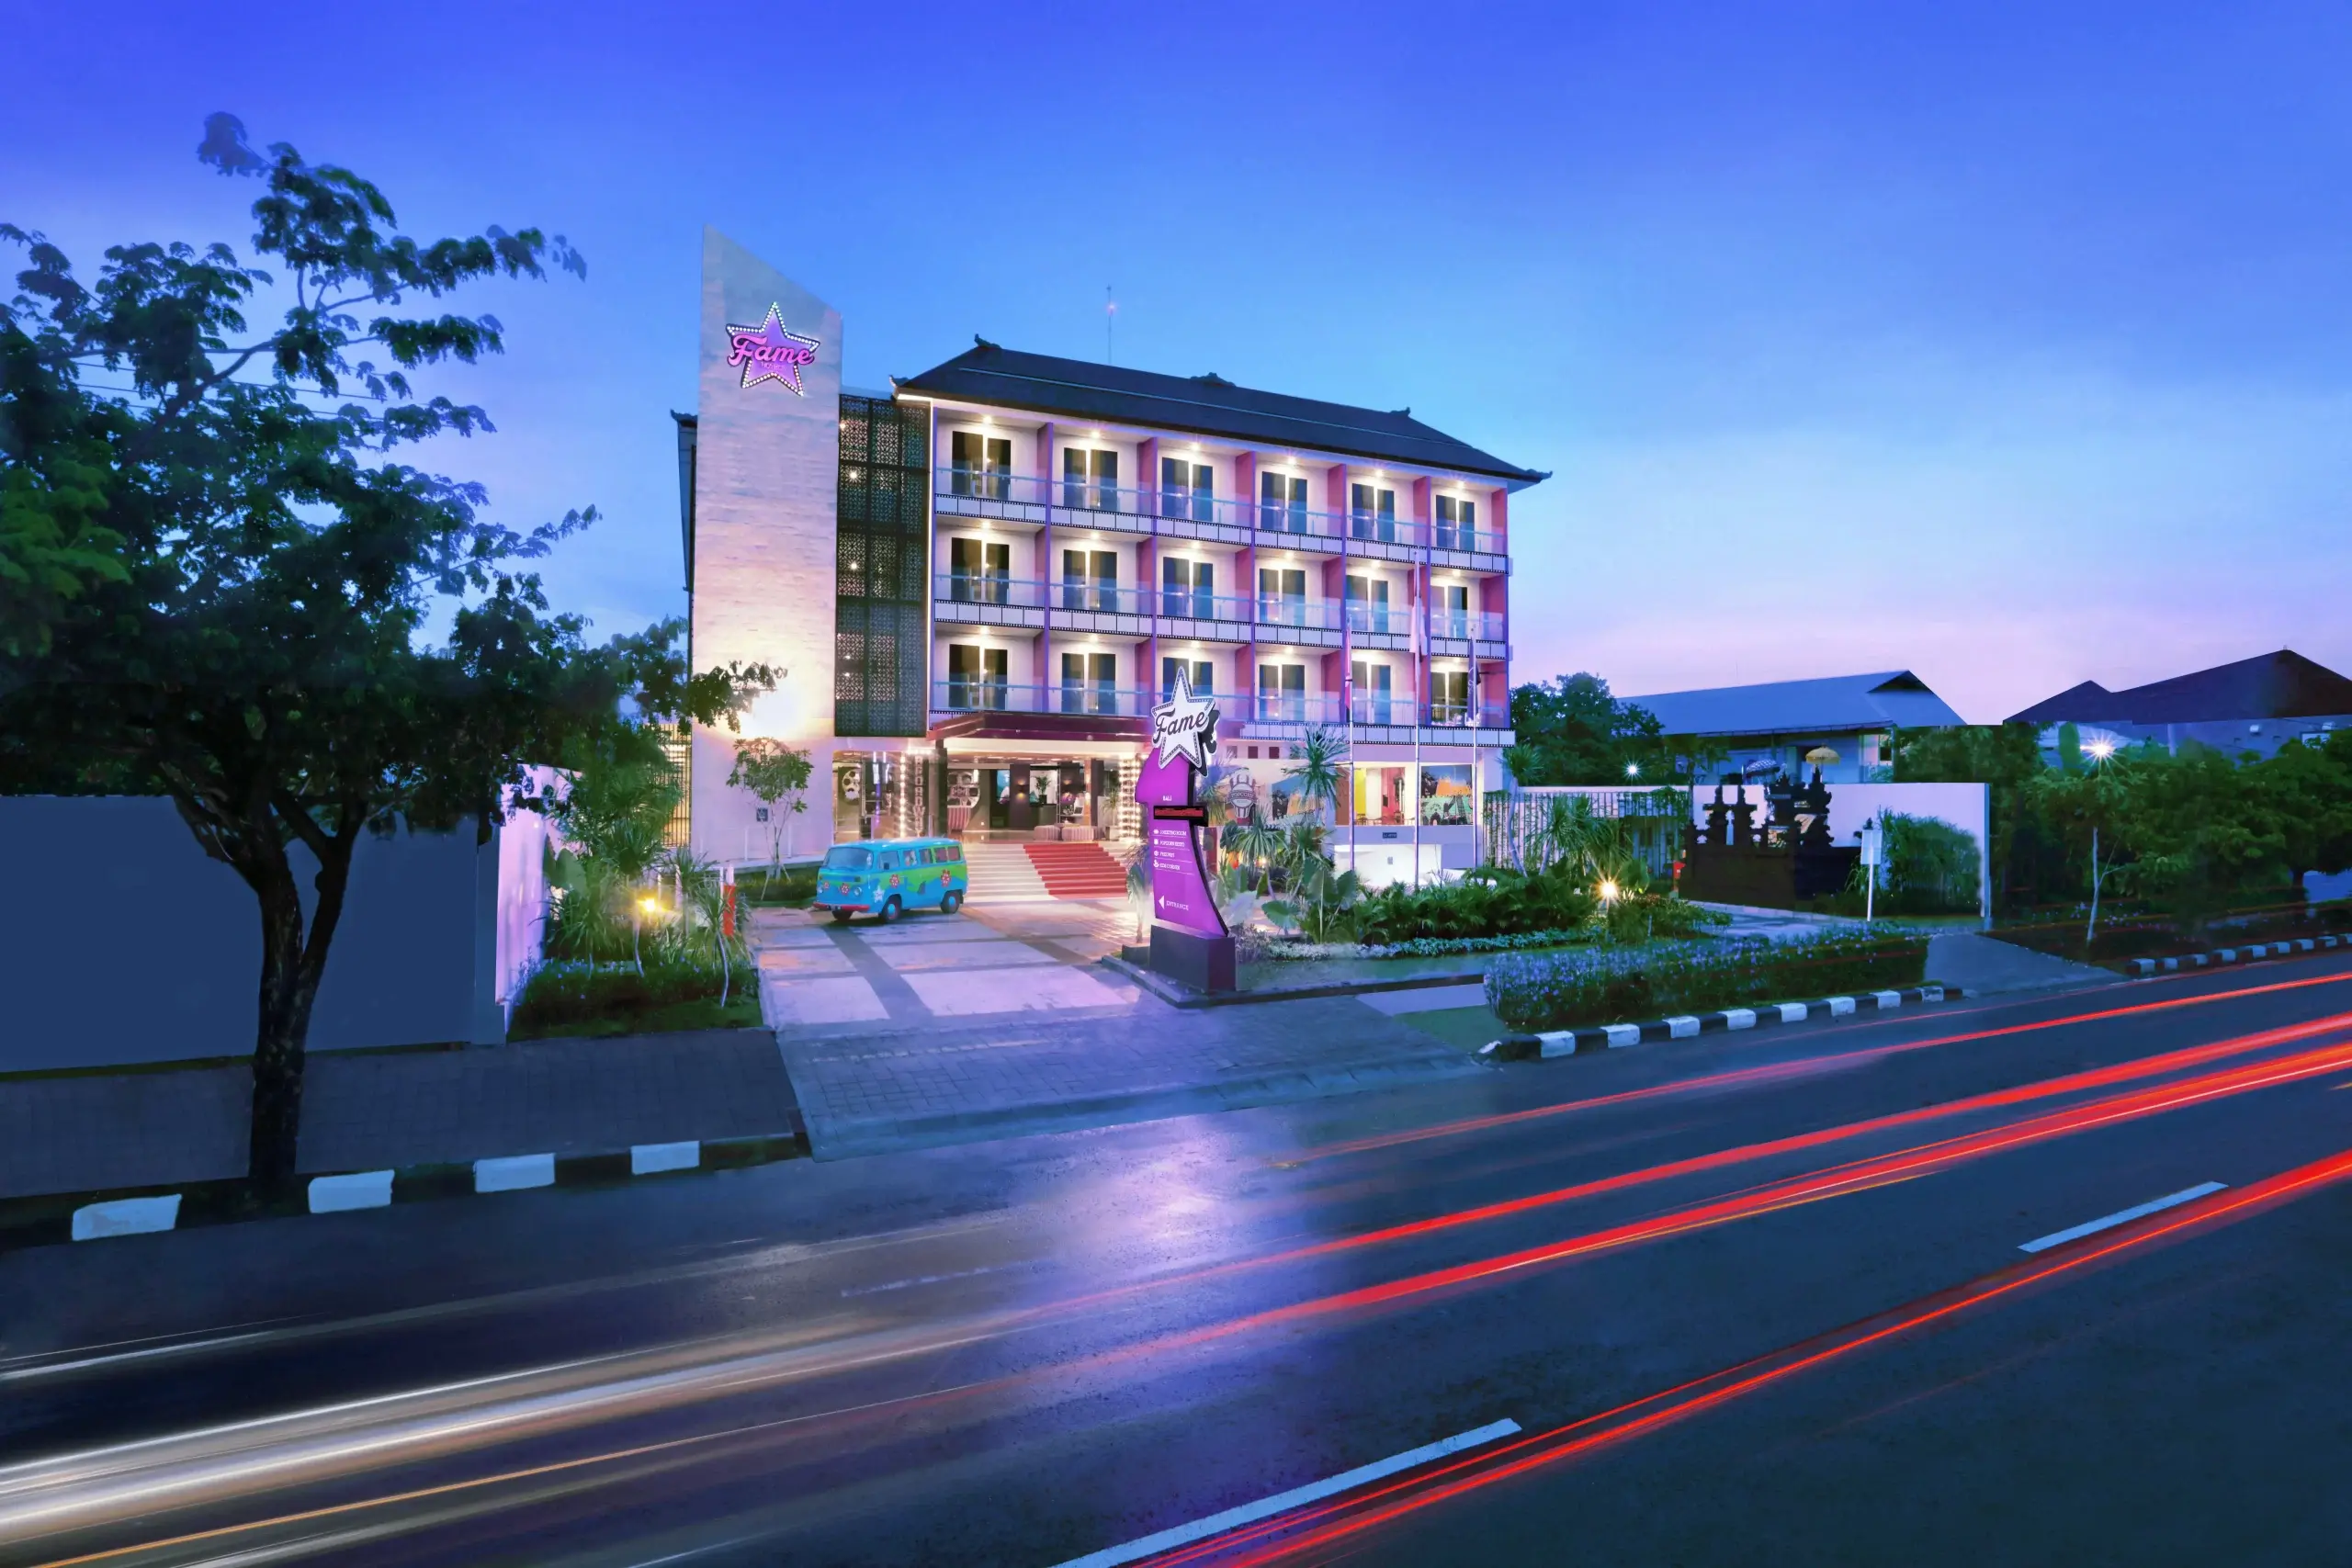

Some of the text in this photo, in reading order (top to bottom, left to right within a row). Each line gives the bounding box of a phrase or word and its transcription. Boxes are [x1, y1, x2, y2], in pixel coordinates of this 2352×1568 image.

[728, 334, 815, 366] Fame
[1152, 707, 1208, 744] Fame
[1166, 900, 1189, 910] ENTRANCE
